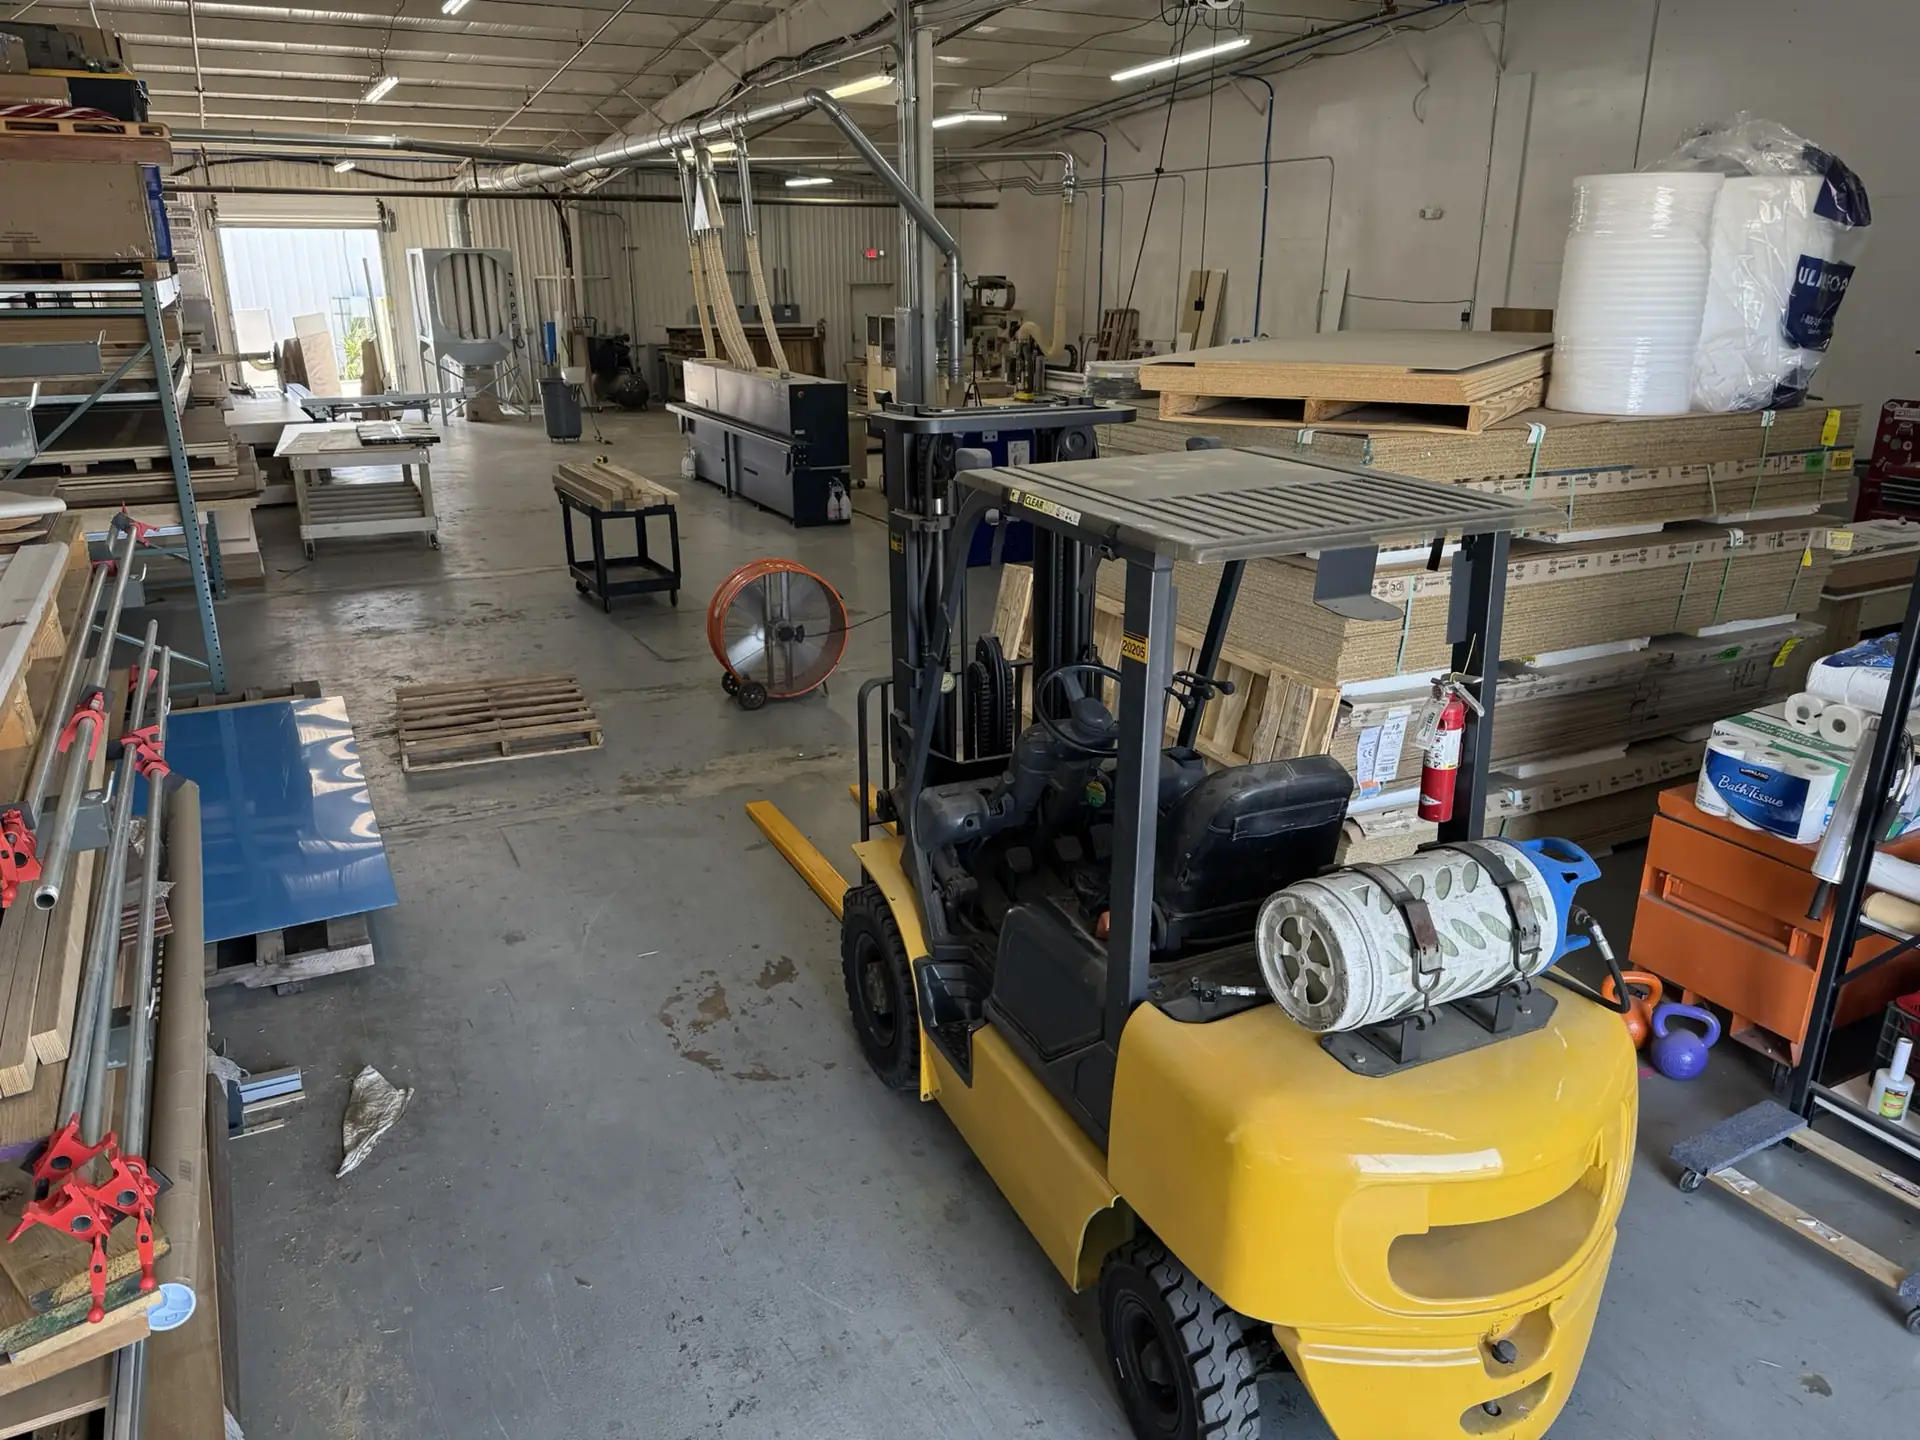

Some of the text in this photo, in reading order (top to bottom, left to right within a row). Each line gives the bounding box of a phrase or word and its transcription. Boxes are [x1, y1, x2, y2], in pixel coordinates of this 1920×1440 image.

[1025, 496, 1044, 510] CLEAR
[1122, 640, 1145, 659] 20205
[1362, 748, 1373, 758] CE
[1718, 775, 1749, 796] Bath
[1747, 785, 1784, 808] Tissue
